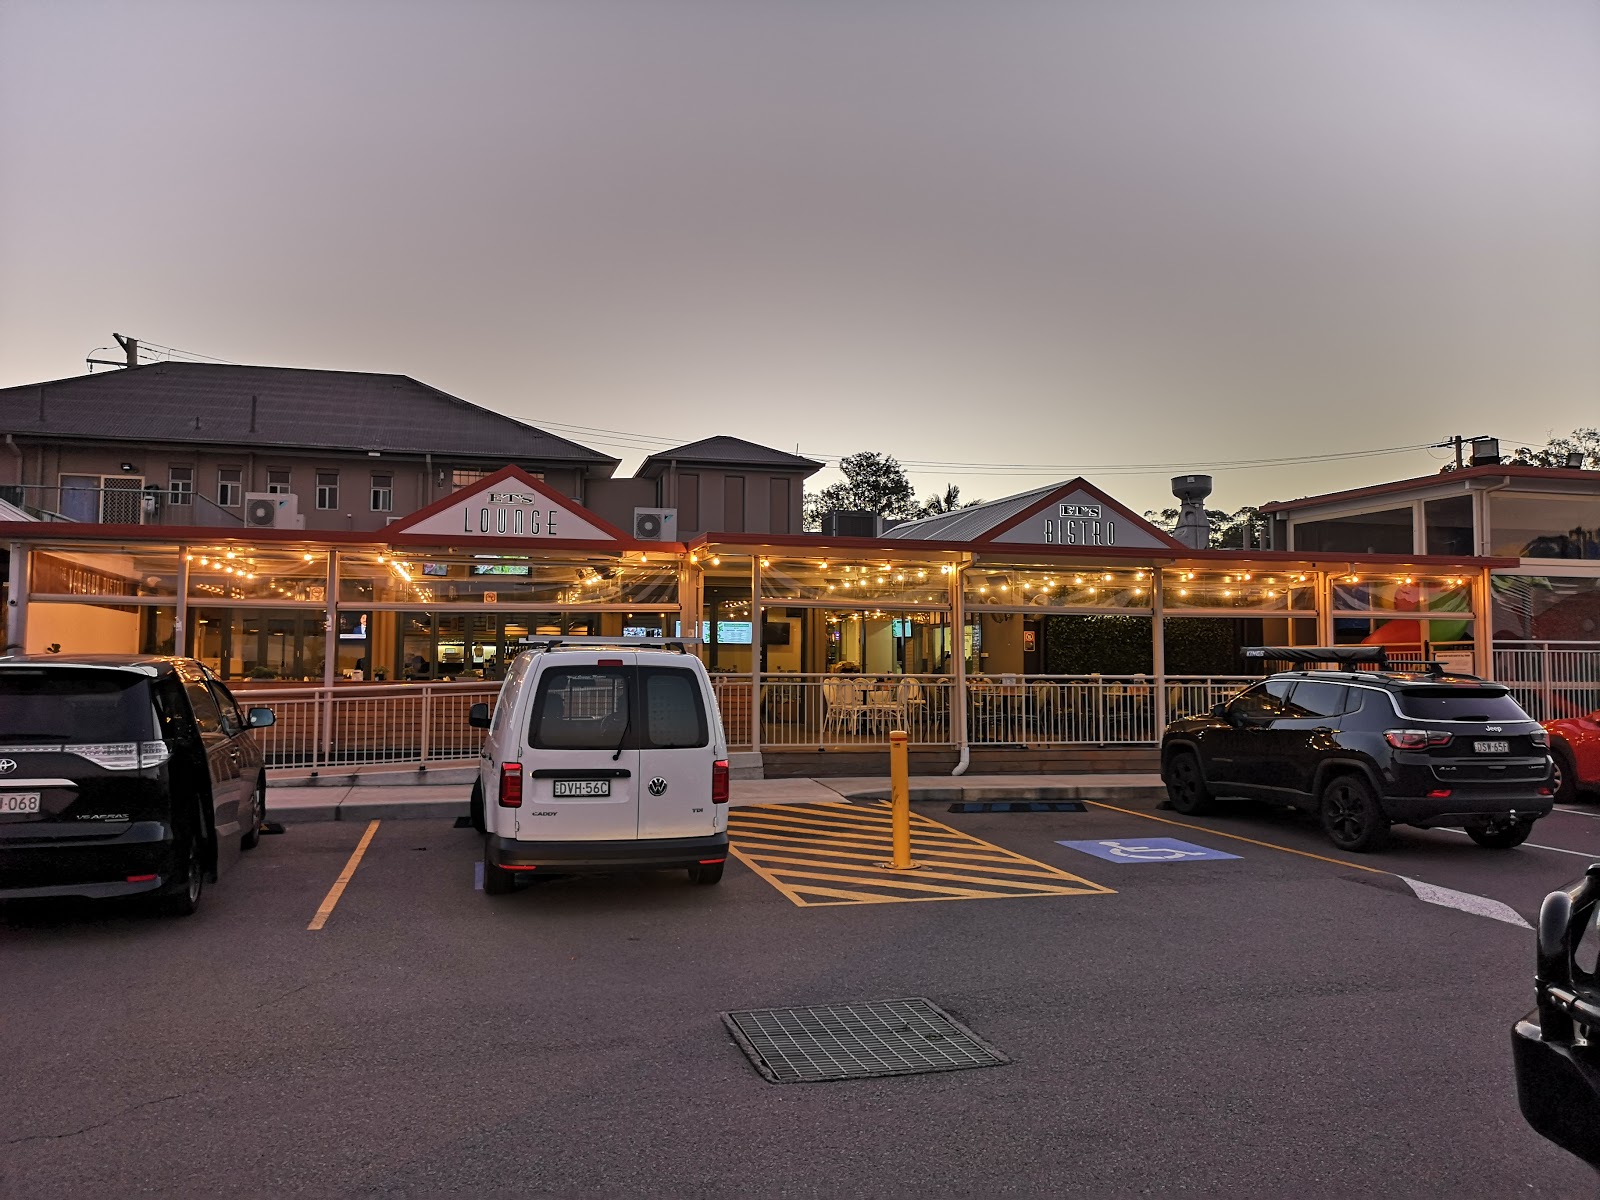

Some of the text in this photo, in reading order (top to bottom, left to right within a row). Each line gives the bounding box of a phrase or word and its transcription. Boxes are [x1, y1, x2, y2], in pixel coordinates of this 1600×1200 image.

[464, 507, 558, 536] LOUNGE
[1043, 519, 1115, 546] BISTRO
[1485, 725, 1503, 733] Jeep
